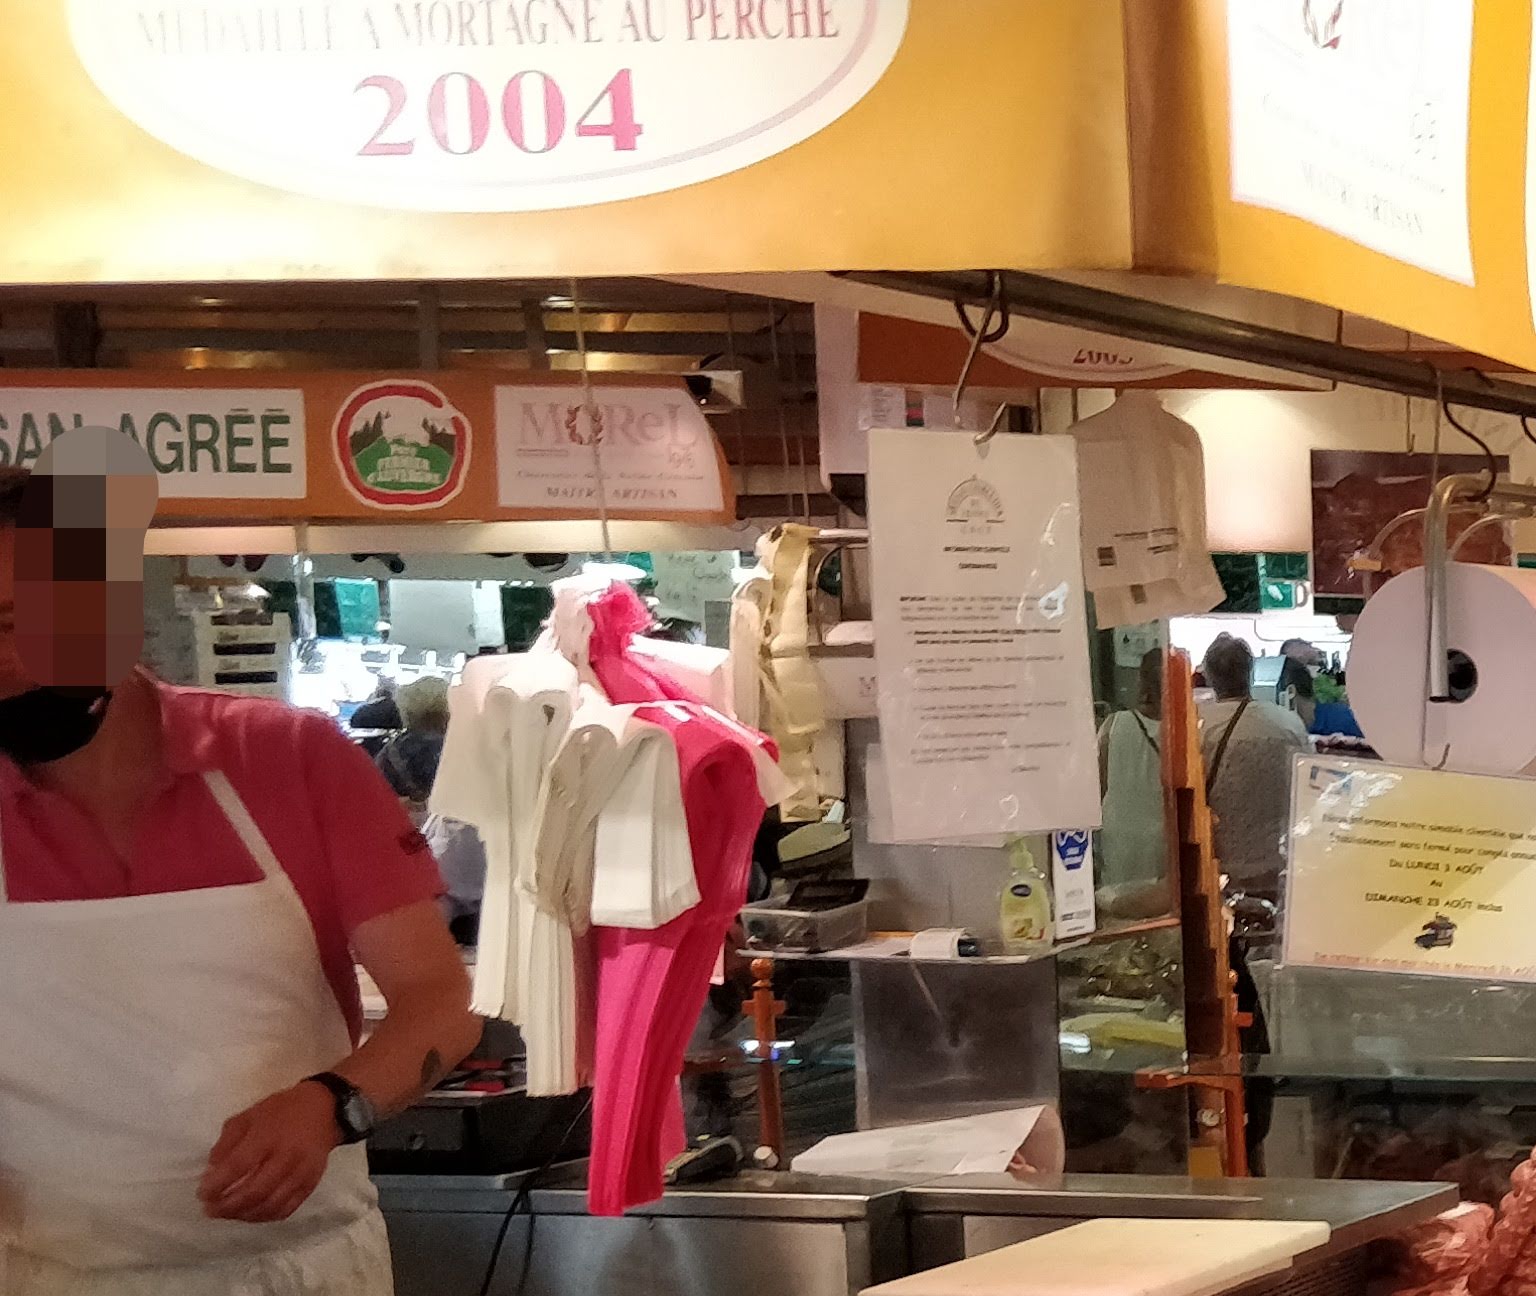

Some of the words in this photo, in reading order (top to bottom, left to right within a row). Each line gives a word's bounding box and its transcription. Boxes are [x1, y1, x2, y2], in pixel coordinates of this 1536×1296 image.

[616, 0, 666, 42] AU
[684, 0, 841, 41] PERCHE
[354, 68, 644, 156] 2004
[1073, 347, 1134, 365] 200
